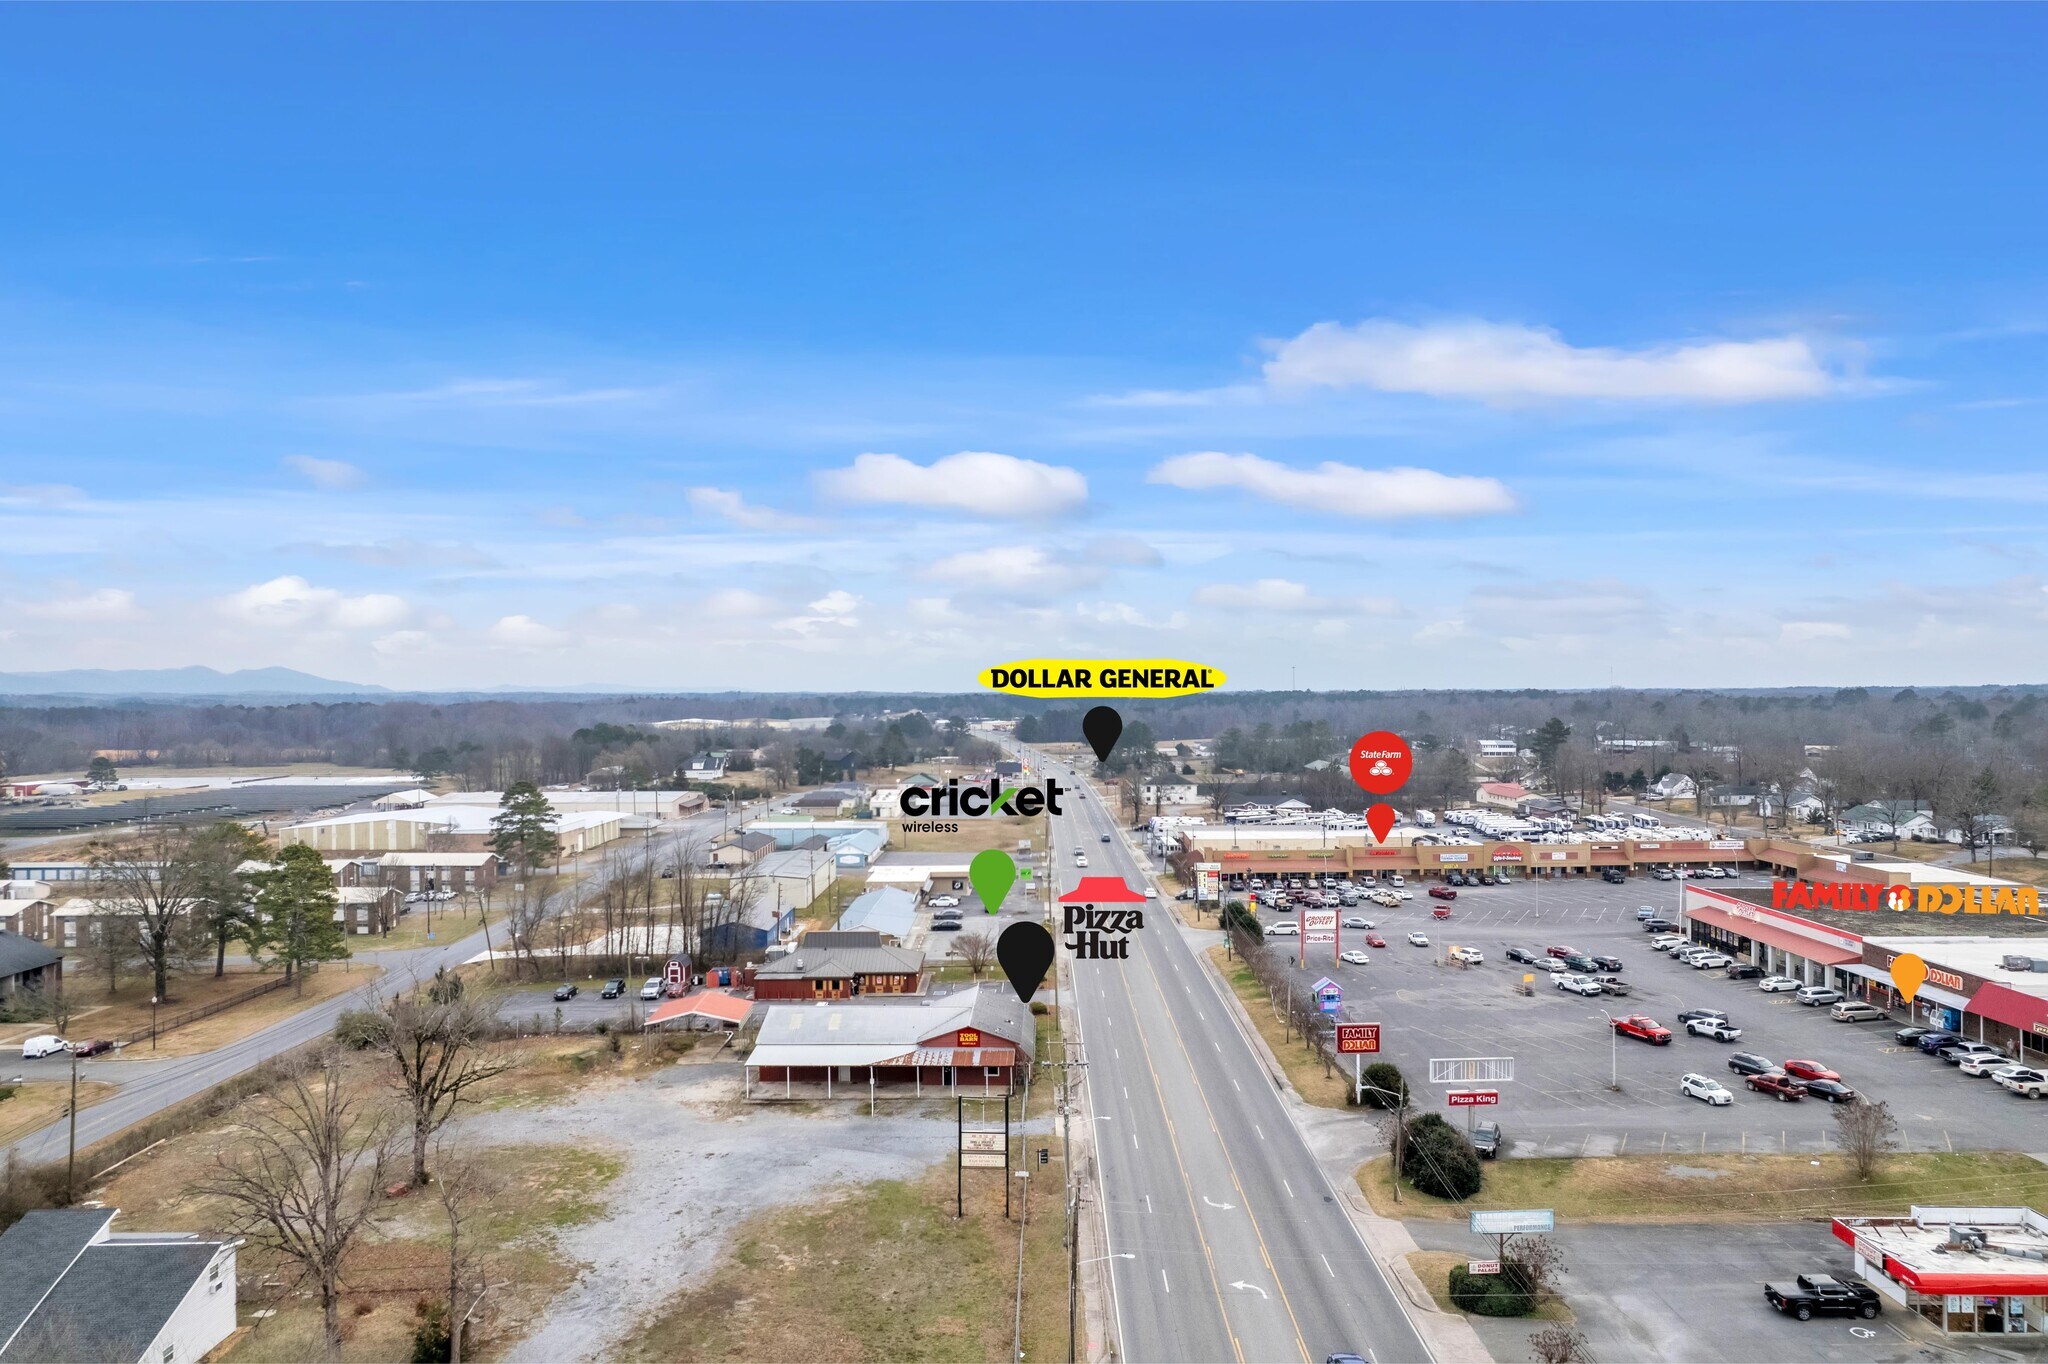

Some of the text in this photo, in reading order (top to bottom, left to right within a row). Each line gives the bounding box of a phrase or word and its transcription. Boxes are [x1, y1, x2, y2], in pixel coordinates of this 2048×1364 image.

[1306, 915, 1335, 923] GROCERY
[1929, 967, 1964, 990] DOLLAR
[1342, 1028, 1377, 1039] FAMILY
[1342, 1039, 1376, 1051] DOLLAR
[1451, 1095, 1496, 1104] Pizza King
[1513, 1224, 1551, 1232] PERFORMANCE
